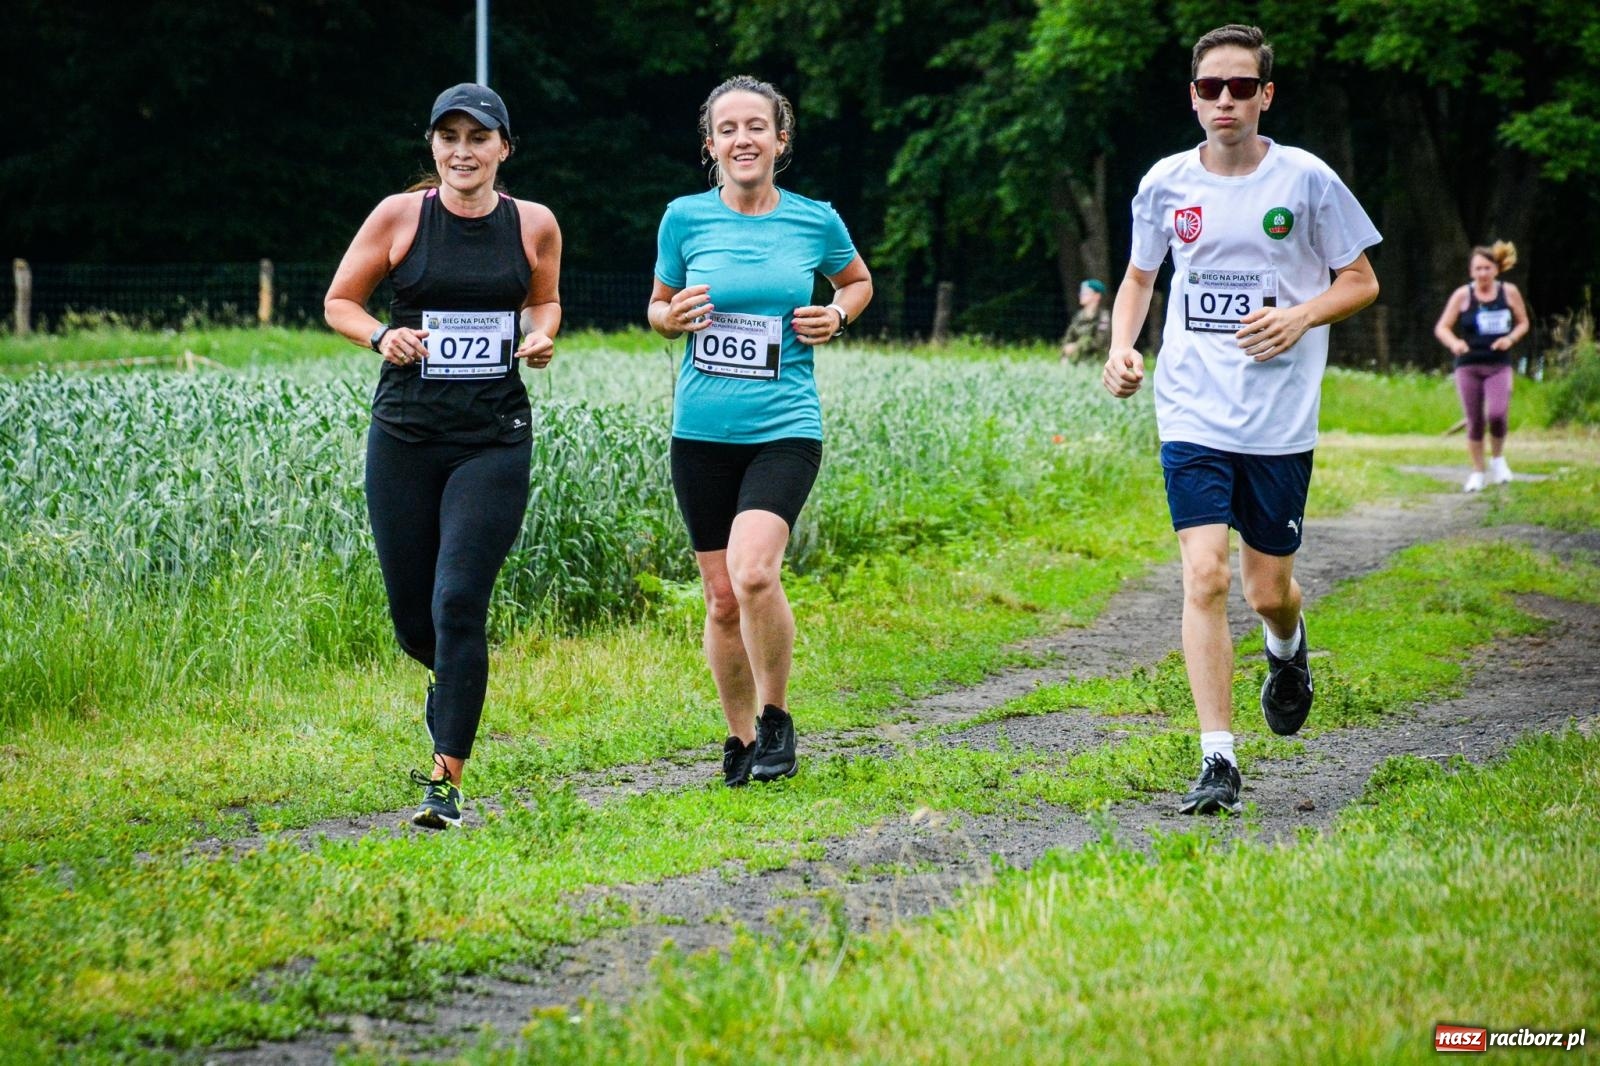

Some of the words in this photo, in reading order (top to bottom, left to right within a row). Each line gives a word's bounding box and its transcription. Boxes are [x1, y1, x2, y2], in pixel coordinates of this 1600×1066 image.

[1232, 274, 1260, 282] PIĄTKĘ
[1200, 292, 1250, 316] 073
[473, 317, 500, 325] PIĄTKĘ
[709, 315, 726, 323] BIEG
[740, 318, 767, 328] PIĄTKĘ
[440, 336, 490, 360] 072
[703, 334, 757, 361] 066
